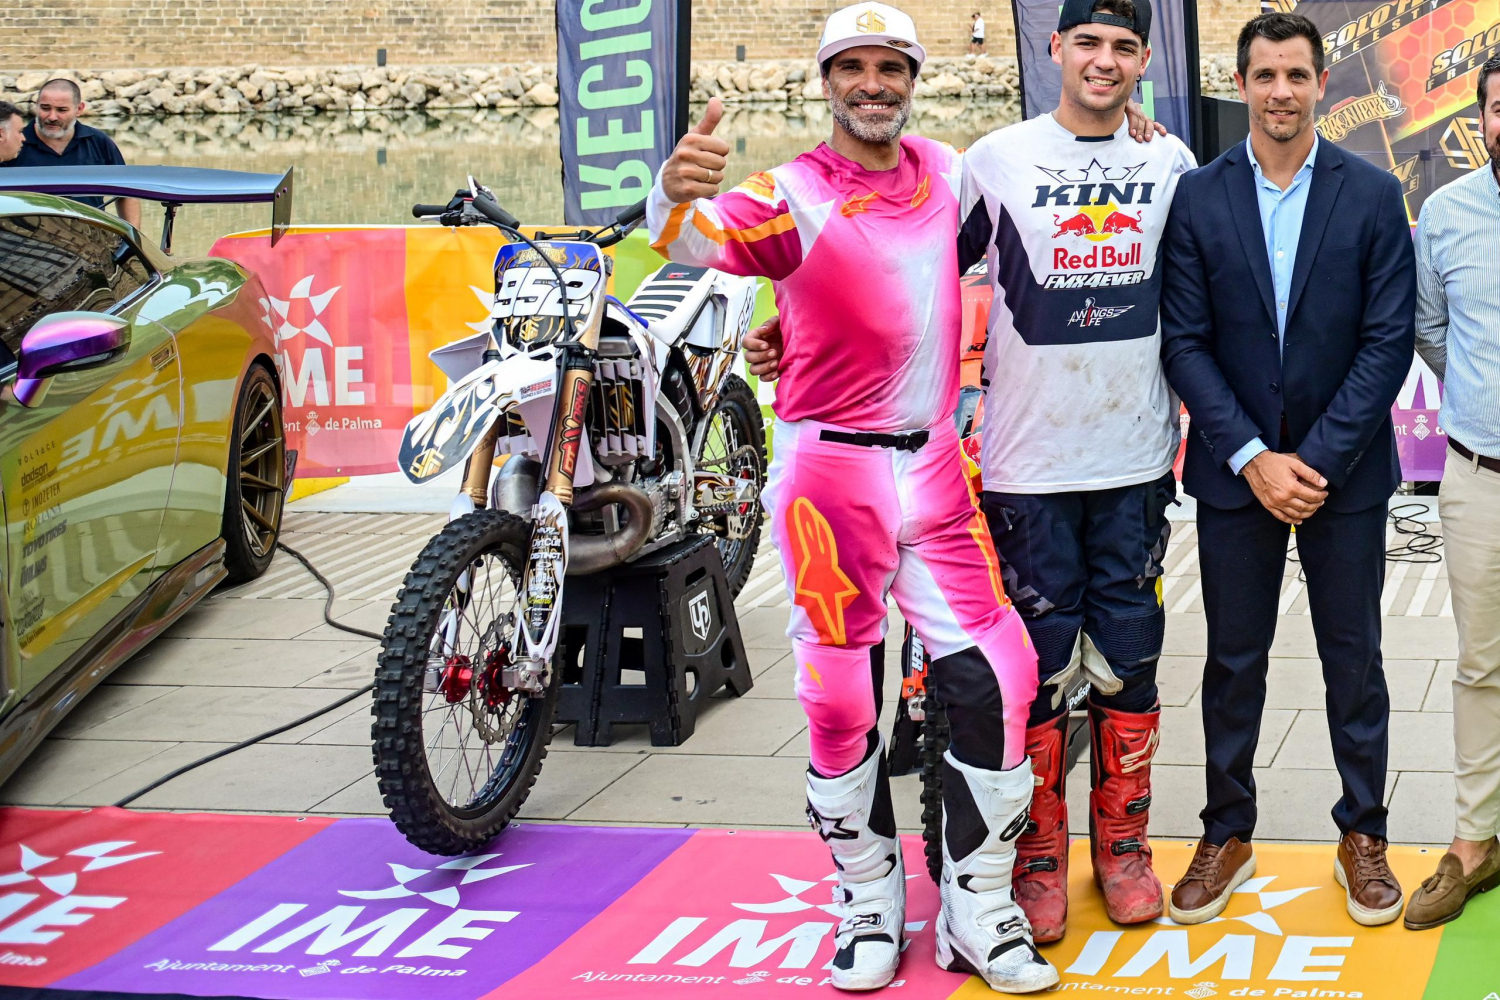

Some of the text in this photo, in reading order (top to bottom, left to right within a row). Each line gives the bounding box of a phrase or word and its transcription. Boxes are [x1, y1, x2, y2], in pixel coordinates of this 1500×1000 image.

[1322, 3, 1391, 54] SOLO
[1031, 182, 1155, 208] KINI
[1053, 243, 1141, 270] Red Bull
[492, 267, 600, 318] 952
[1044, 271, 1144, 290] FMX4EVER
[1075, 308, 1115, 319] WINGS
[1080, 317, 1102, 328] LIFE
[283, 346, 365, 408] ME
[325, 416, 382, 430] de Palma
[21, 463, 48, 487] dodson
[206, 903, 521, 958] IME
[627, 916, 838, 970] IM
[1064, 930, 1354, 980] IME
[0, 952, 47, 966] lma
[144, 957, 468, 979] Ajuntament de Palma
[572, 971, 728, 984] Ajuntament
[777, 975, 812, 985] de
[1229, 987, 1257, 997] de
[1274, 987, 1364, 999] Palma
